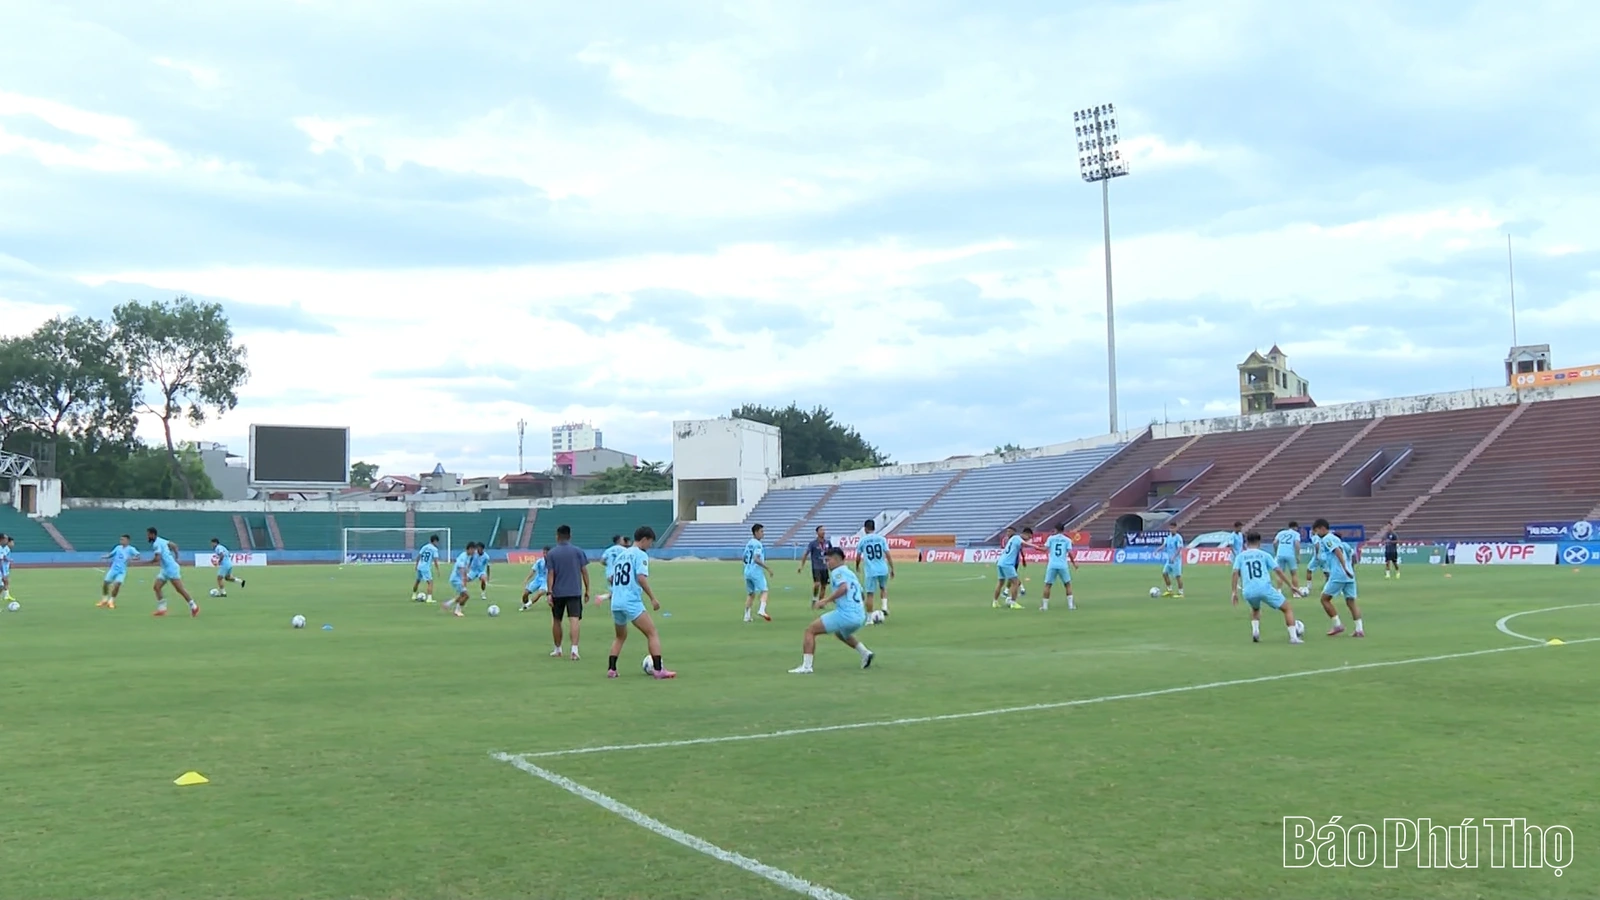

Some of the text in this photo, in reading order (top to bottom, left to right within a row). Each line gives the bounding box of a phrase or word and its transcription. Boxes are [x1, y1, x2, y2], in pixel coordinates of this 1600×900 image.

[1281, 534, 1293, 545] 22
[865, 543, 883, 561] 99
[936, 551, 950, 560] FPT
[984, 550, 1003, 560] VPF
[1055, 543, 1063, 557] 5
[1200, 551, 1220, 562] FPT
[1496, 545, 1535, 560] VPF
[614, 562, 631, 586] 68
[1246, 560, 1262, 580] 18
